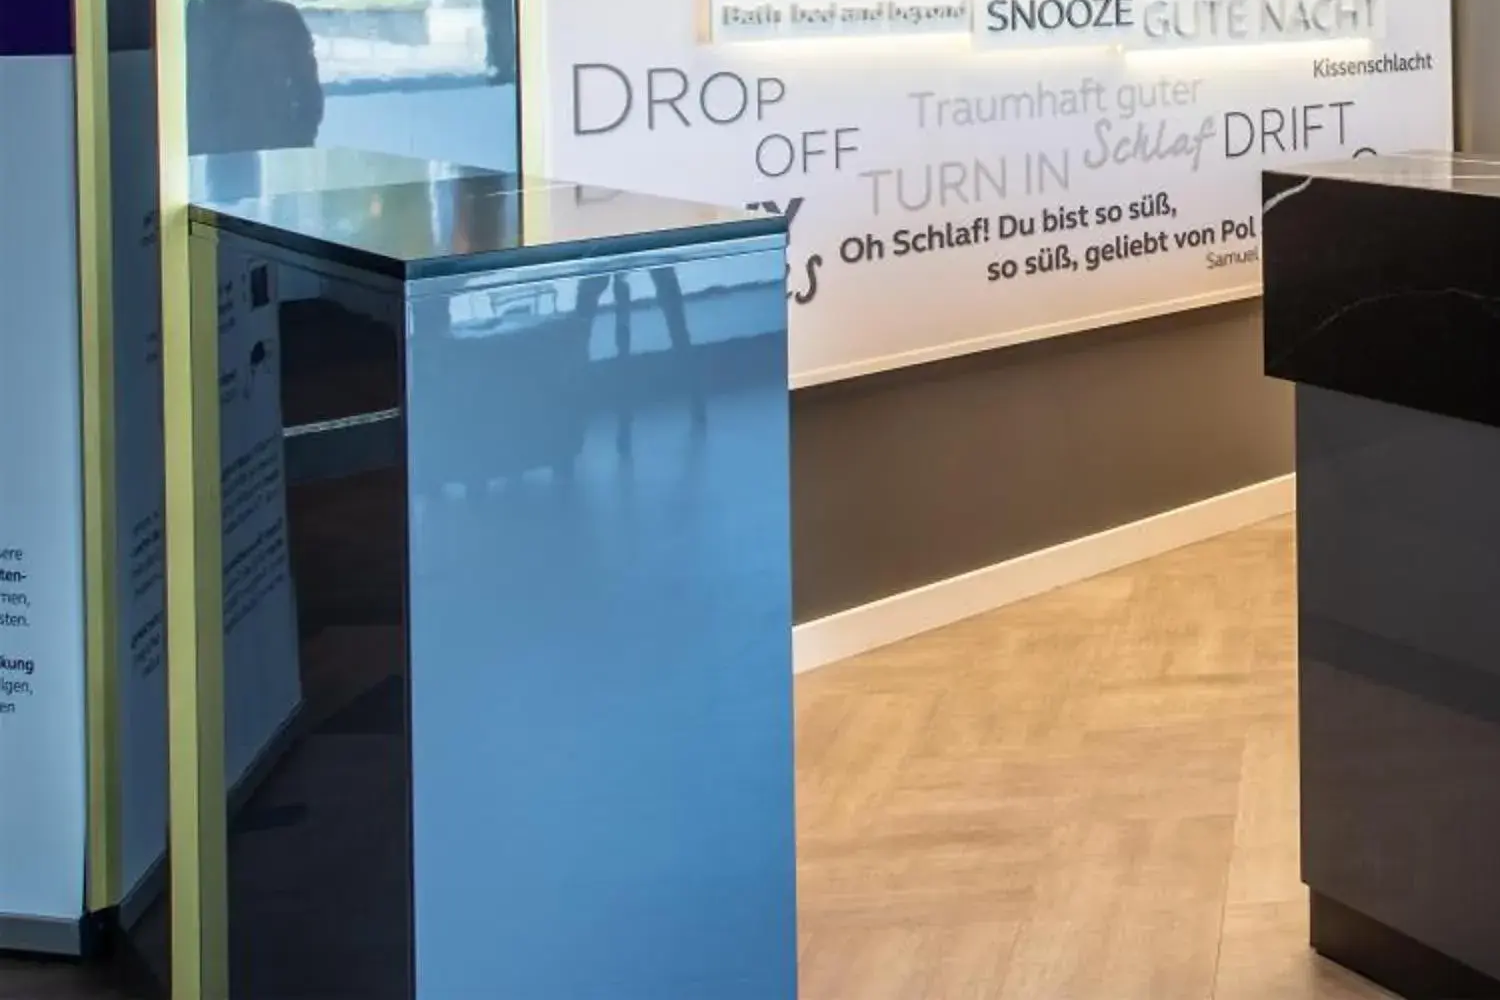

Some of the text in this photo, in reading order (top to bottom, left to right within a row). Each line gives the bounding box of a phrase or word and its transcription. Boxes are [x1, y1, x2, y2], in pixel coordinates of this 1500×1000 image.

[1313, 53, 1433, 79] Kissenschlacht
[572, 63, 786, 136] DROP
[909, 77, 1203, 129] Traumhaft guter
[755, 127, 860, 178] OFF
[1083, 116, 1217, 174] Schlaf
[1223, 101, 1356, 159] DRIFT
[859, 153, 1007, 216] TURN
[1024, 149, 1070, 194] IN
[840, 192, 1178, 264] Oh Schlaf! Du bist so süß,
[986, 215, 1257, 283] so süß, geliebt von Pol
[1205, 247, 1260, 271] Samuel
